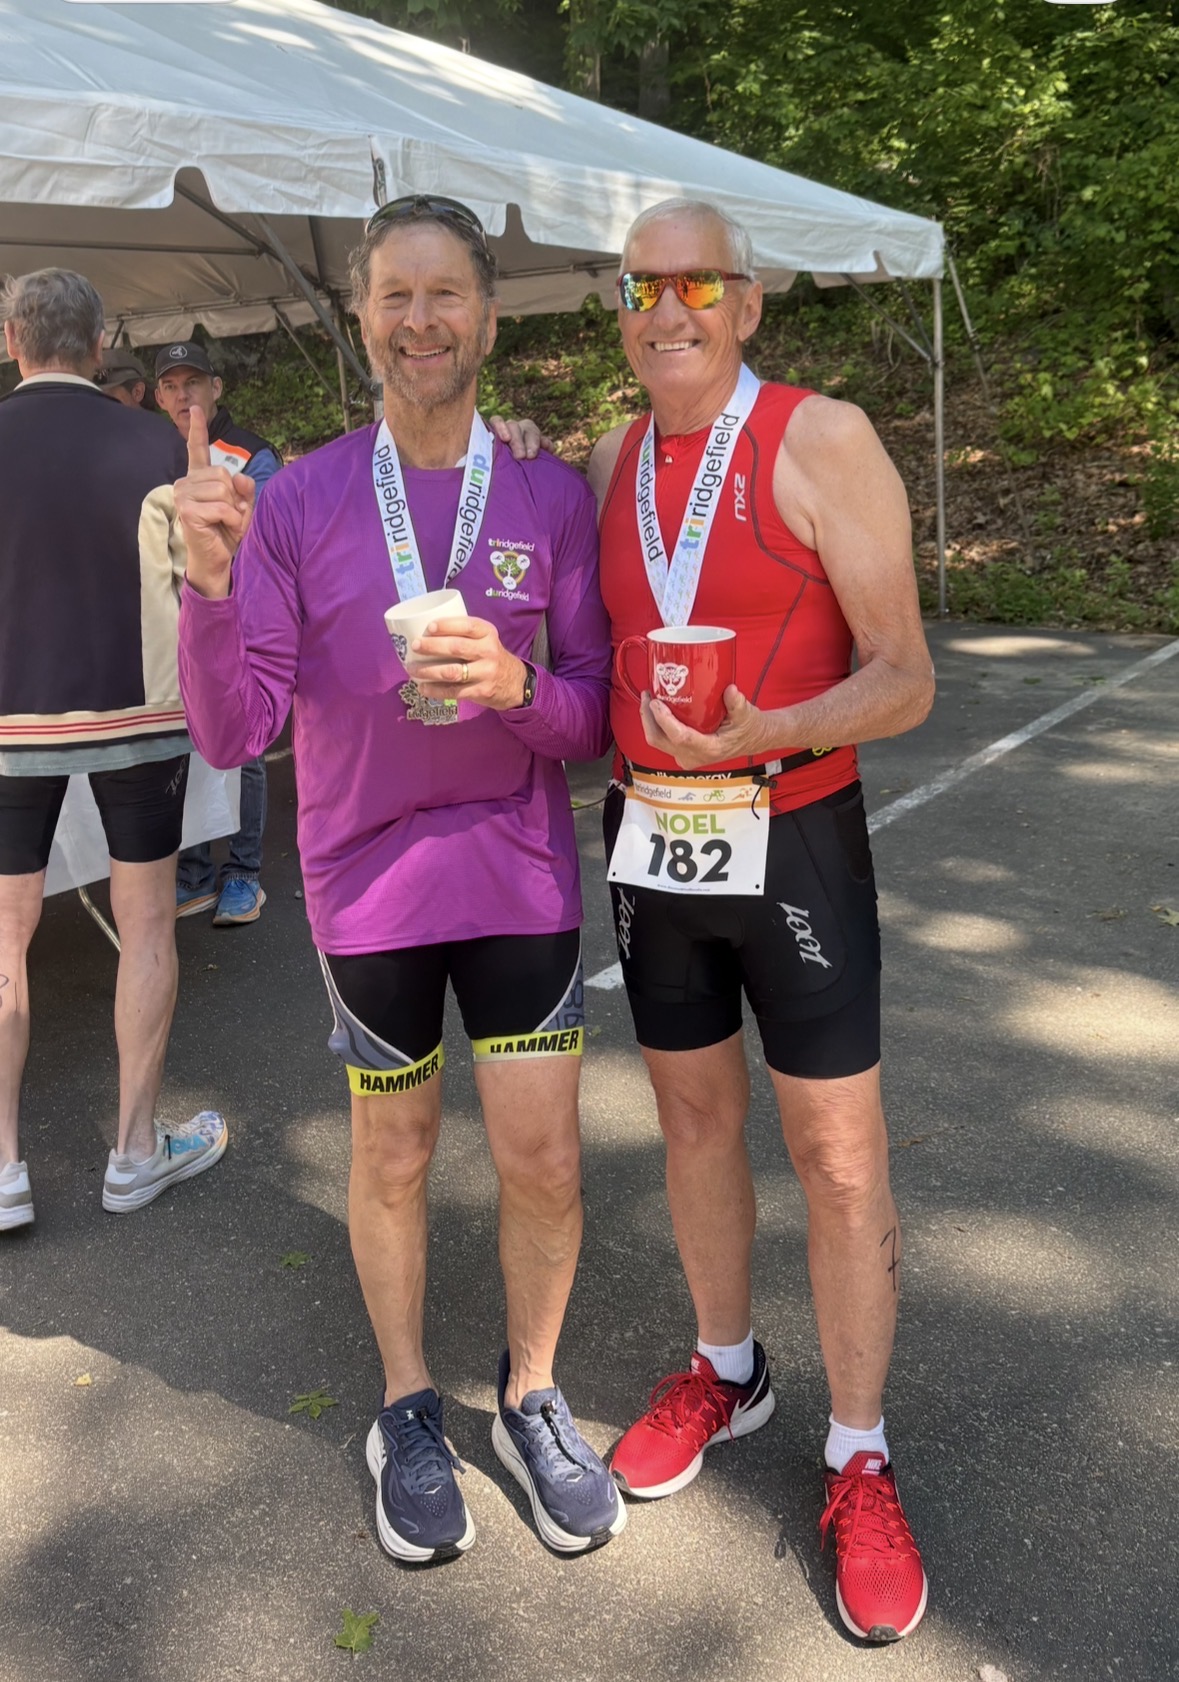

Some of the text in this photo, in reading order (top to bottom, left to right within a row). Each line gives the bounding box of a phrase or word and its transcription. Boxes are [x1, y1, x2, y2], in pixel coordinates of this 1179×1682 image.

[680, 412, 740, 550] triridgefield
[733, 472, 747, 522] 2XU
[374, 444, 415, 575] triridgefield
[488, 538, 535, 552] triridgefield
[485, 587, 530, 602] duridgefield
[634, 782, 672, 799] triridgefield
[655, 811, 726, 835] NOEL
[647, 833, 733, 884] 182
[359, 1053, 440, 1093] HAMMER
